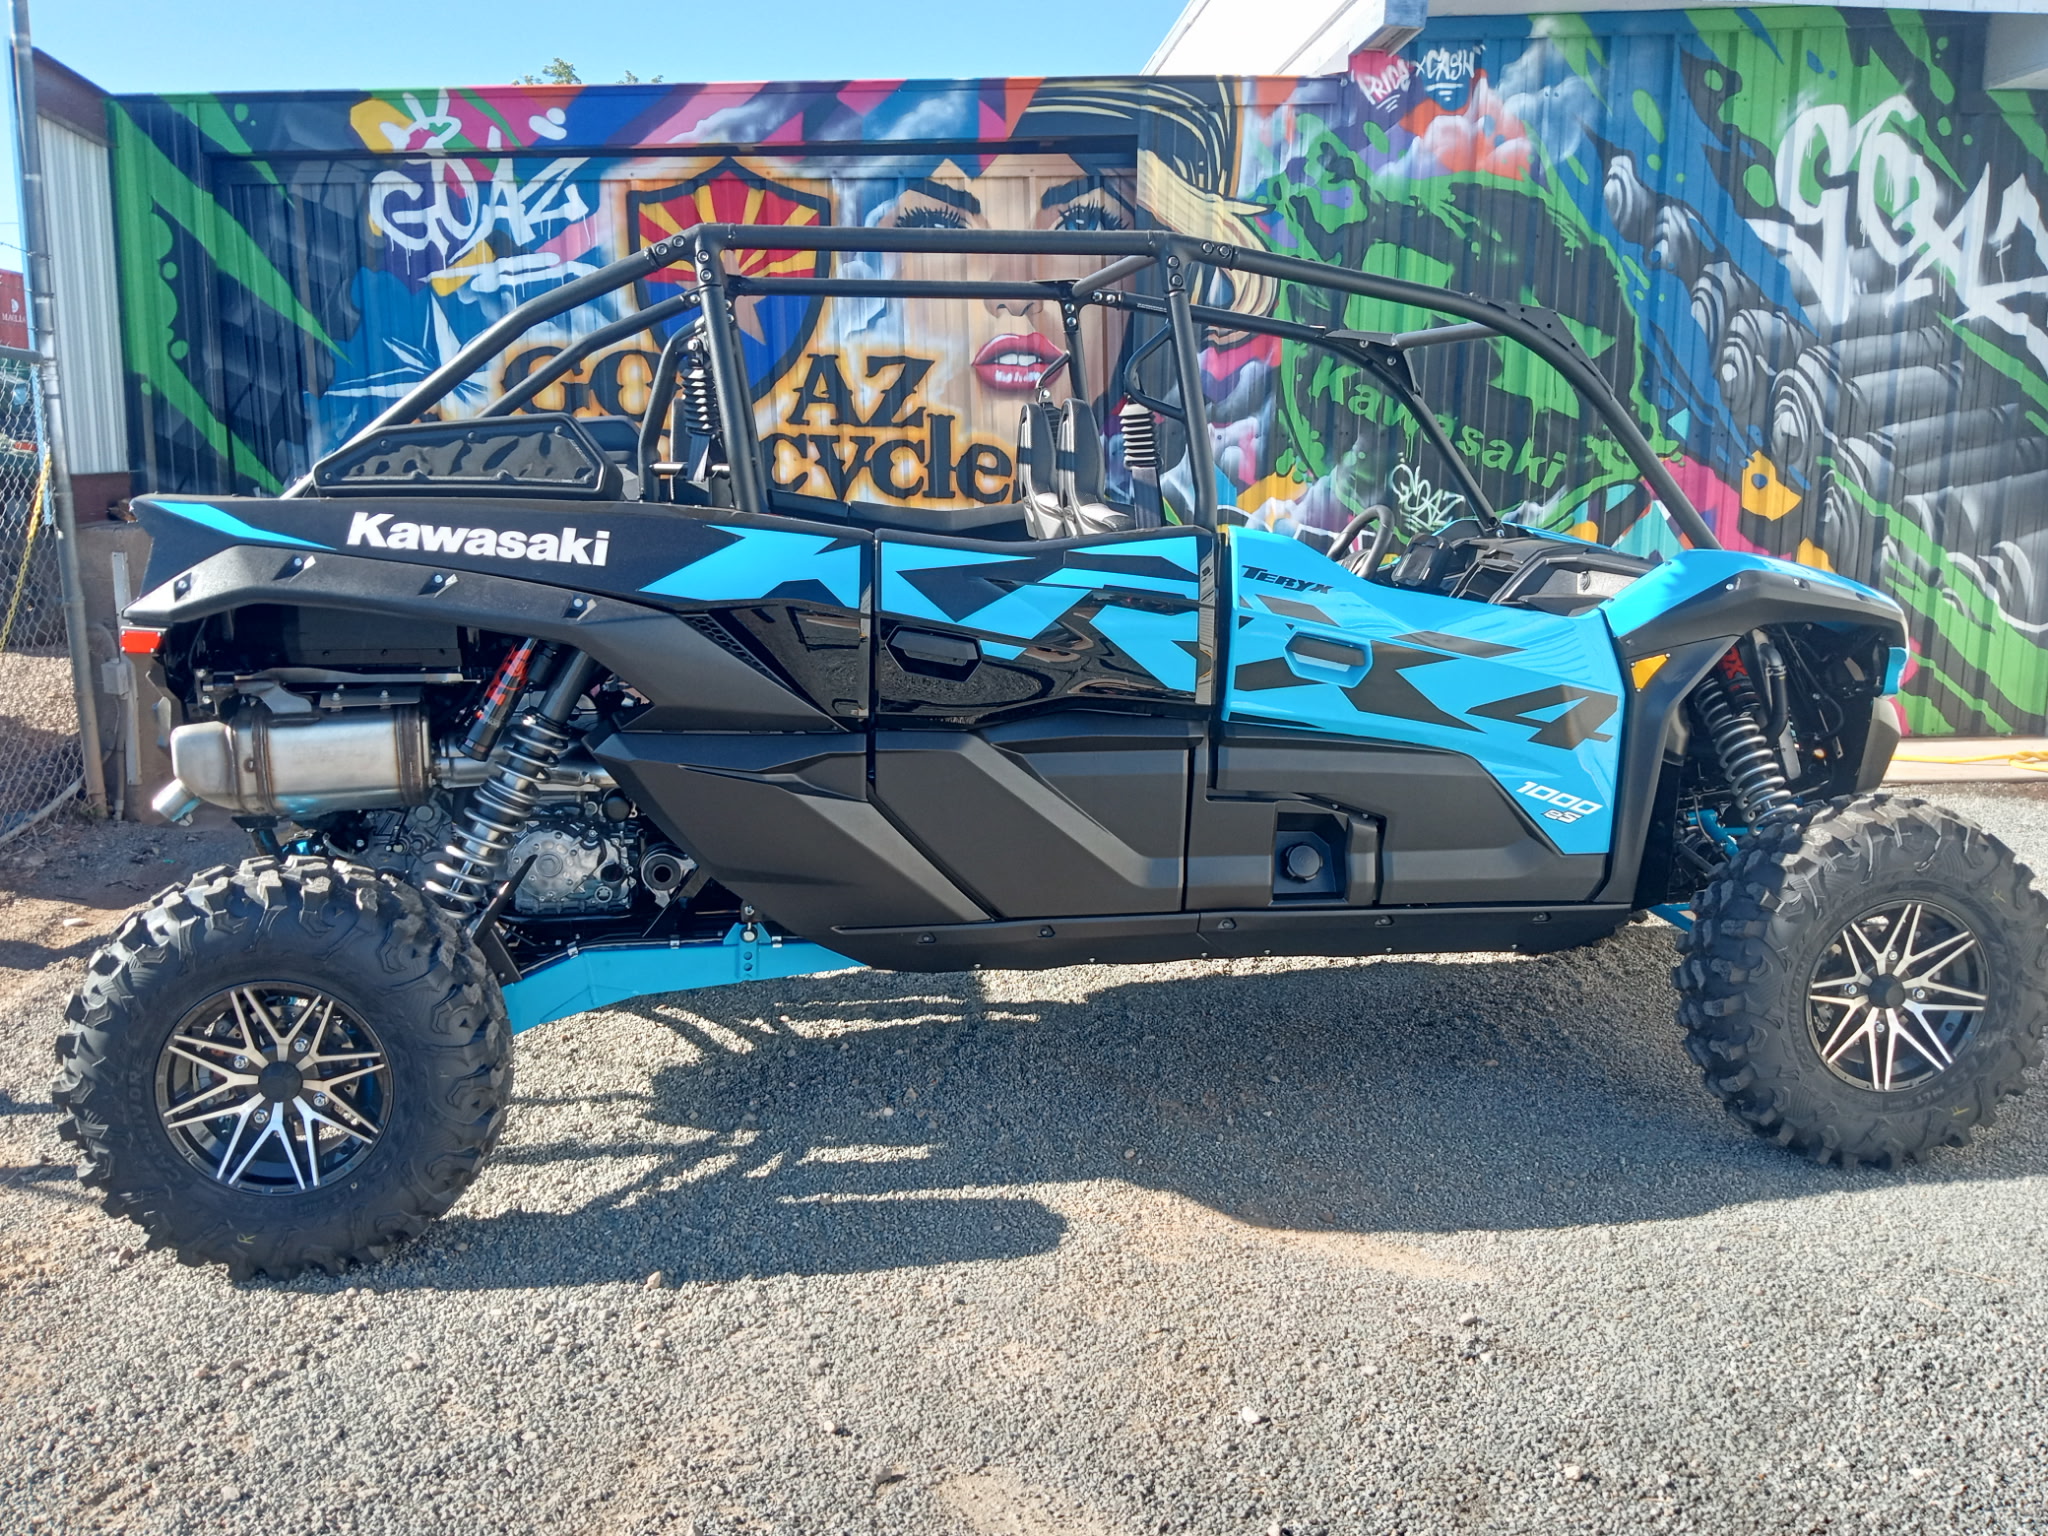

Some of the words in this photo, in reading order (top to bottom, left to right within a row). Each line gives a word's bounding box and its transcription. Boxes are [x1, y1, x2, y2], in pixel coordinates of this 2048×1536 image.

[787, 353, 935, 427] AZ
[758, 413, 1020, 504] cycle
[346, 511, 610, 567] Kawasaki
[1516, 781, 1603, 815] 1000
